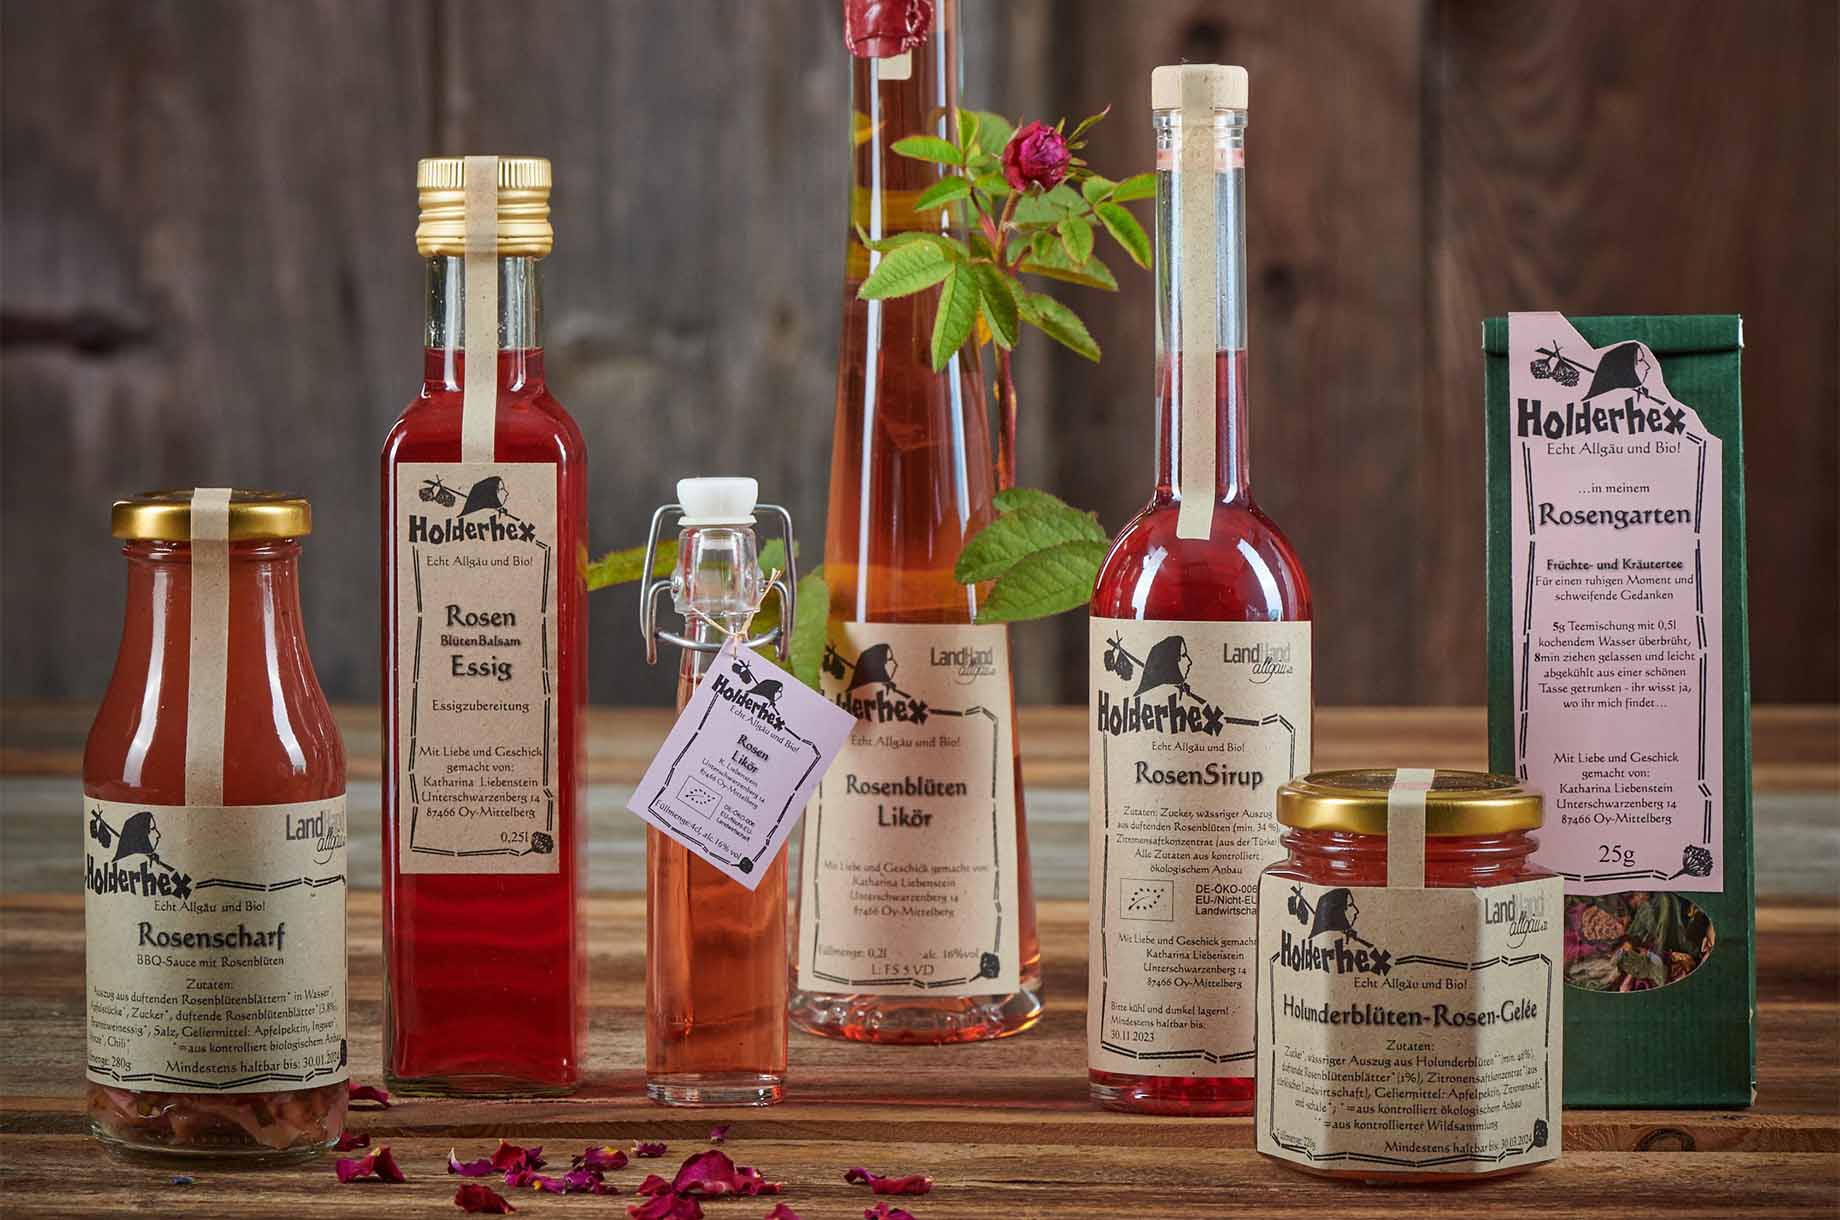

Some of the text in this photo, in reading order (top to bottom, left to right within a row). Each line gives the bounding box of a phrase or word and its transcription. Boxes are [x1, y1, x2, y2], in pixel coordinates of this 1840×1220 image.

[1517, 397, 1686, 439] Holderhex
[1547, 442, 1681, 457] Echt Allgäu und Bio!
[1606, 484, 1650, 493] meinem
[1538, 503, 1692, 529] Rosengarten
[409, 514, 536, 544] Holderhex
[427, 556, 533, 569] Echt Allgäu und Bio!
[1547, 558, 1683, 571] Früchte- und Kräutertee
[1536, 575, 1694, 587] Für einen ruhigen Moment und
[1555, 590, 1673, 602] schweifende Gedanken
[445, 604, 517, 627] Rosen
[1553, 620, 1677, 633] 5g Teemischung mit 0,5l
[440, 635, 521, 647] BlütenBalsam
[1539, 636, 1692, 647] kochendem Wasser überbrüht,
[1534, 651, 1695, 663] 8min ziehen gelassen und leicht
[451, 655, 513, 680] Essig
[1544, 668, 1593, 679] abgekühlt
[1618, 669, 1642, 677] einer
[1538, 683, 1568, 693] Tasse
[1571, 684, 1621, 694] getrunken
[1632, 684, 1645, 692] ihr
[1648, 683, 1675, 692] wisst
[1678, 684, 1692, 694] ja,
[432, 700, 529, 713] Essigzubereitung
[711, 674, 786, 732] Holderhex
[836, 691, 929, 725] derhex
[1582, 699, 1595, 708] ihr
[1598, 699, 1622, 708] mich
[1098, 690, 1224, 736] Holderhex
[728, 705, 746, 721] Echt
[770, 731, 784, 744] und
[736, 734, 769, 762] Rosen
[915, 737, 936, 747] und
[1152, 741, 1244, 753] Echt Allgäu und Bio!
[418, 746, 543, 757] Mit Liebe und Geschick
[731, 750, 759, 774] Likör
[1553, 752, 1679, 764] Mit Liebe und Geschick
[447, 762, 490, 773] gemacht
[1134, 761, 1264, 791] RosenSirup
[1582, 768, 1625, 780] gemacht
[423, 777, 538, 787] Katharina Liebenstein
[846, 774, 967, 796] Rosenblüten
[1559, 783, 1673, 794] Katharina Liebenstein
[421, 792, 527, 803] Unterschwarzenberg
[1557, 800, 1677, 810] Unterschwarzenberg 14
[426, 807, 536, 818] 87466 Oy-Mittelberg
[877, 805, 933, 827] Likör
[1196, 809, 1239, 820] wässriger
[1242, 809, 1272, 819] Auszug
[1562, 813, 1672, 825] 87466 Oy-Mittelberg
[1174, 823, 1230, 832] Rosenblüten
[1599, 845, 1635, 867] 25g
[85, 854, 192, 899] Holderhex
[154, 900, 265, 914] Echt Allgäu und Bio!
[138, 922, 286, 951] Rosenscharf
[1134, 934, 1219, 946] Liebe und Geschick
[1146, 949, 1244, 960] Katharina Liebenstein
[1280, 930, 1392, 976] Holderhex
[136, 954, 284, 969] BBQ-Sauce mit Rosenblüten
[1144, 963, 1235, 975] Unterschwarzenberg
[1174, 978, 1242, 989] Oy-Mittelberg
[1354, 977, 1467, 991] Echt Allgäu und Bio!
[131, 992, 178, 1004] duftenden
[1165, 1005, 1229, 1016] dunkel lagern!
[1284, 993, 1537, 1028] Holunderblüten-Rosen-Gelée
[1156, 1019, 1206, 1029] haltbar bis:
[153, 1025, 179, 1038] Salz,
[1385, 1040, 1435, 1052] Zutaten:
[165, 1061, 237, 1073] Mindestens
[240, 1059, 280, 1073] haltbar
[1394, 1057, 1414, 1067] aus
[1375, 1088, 1446, 1100] Geliermittel:
[1378, 1104, 1438, 1115] kontrolliert
[1354, 1119, 1425, 1130] kontrollierter
